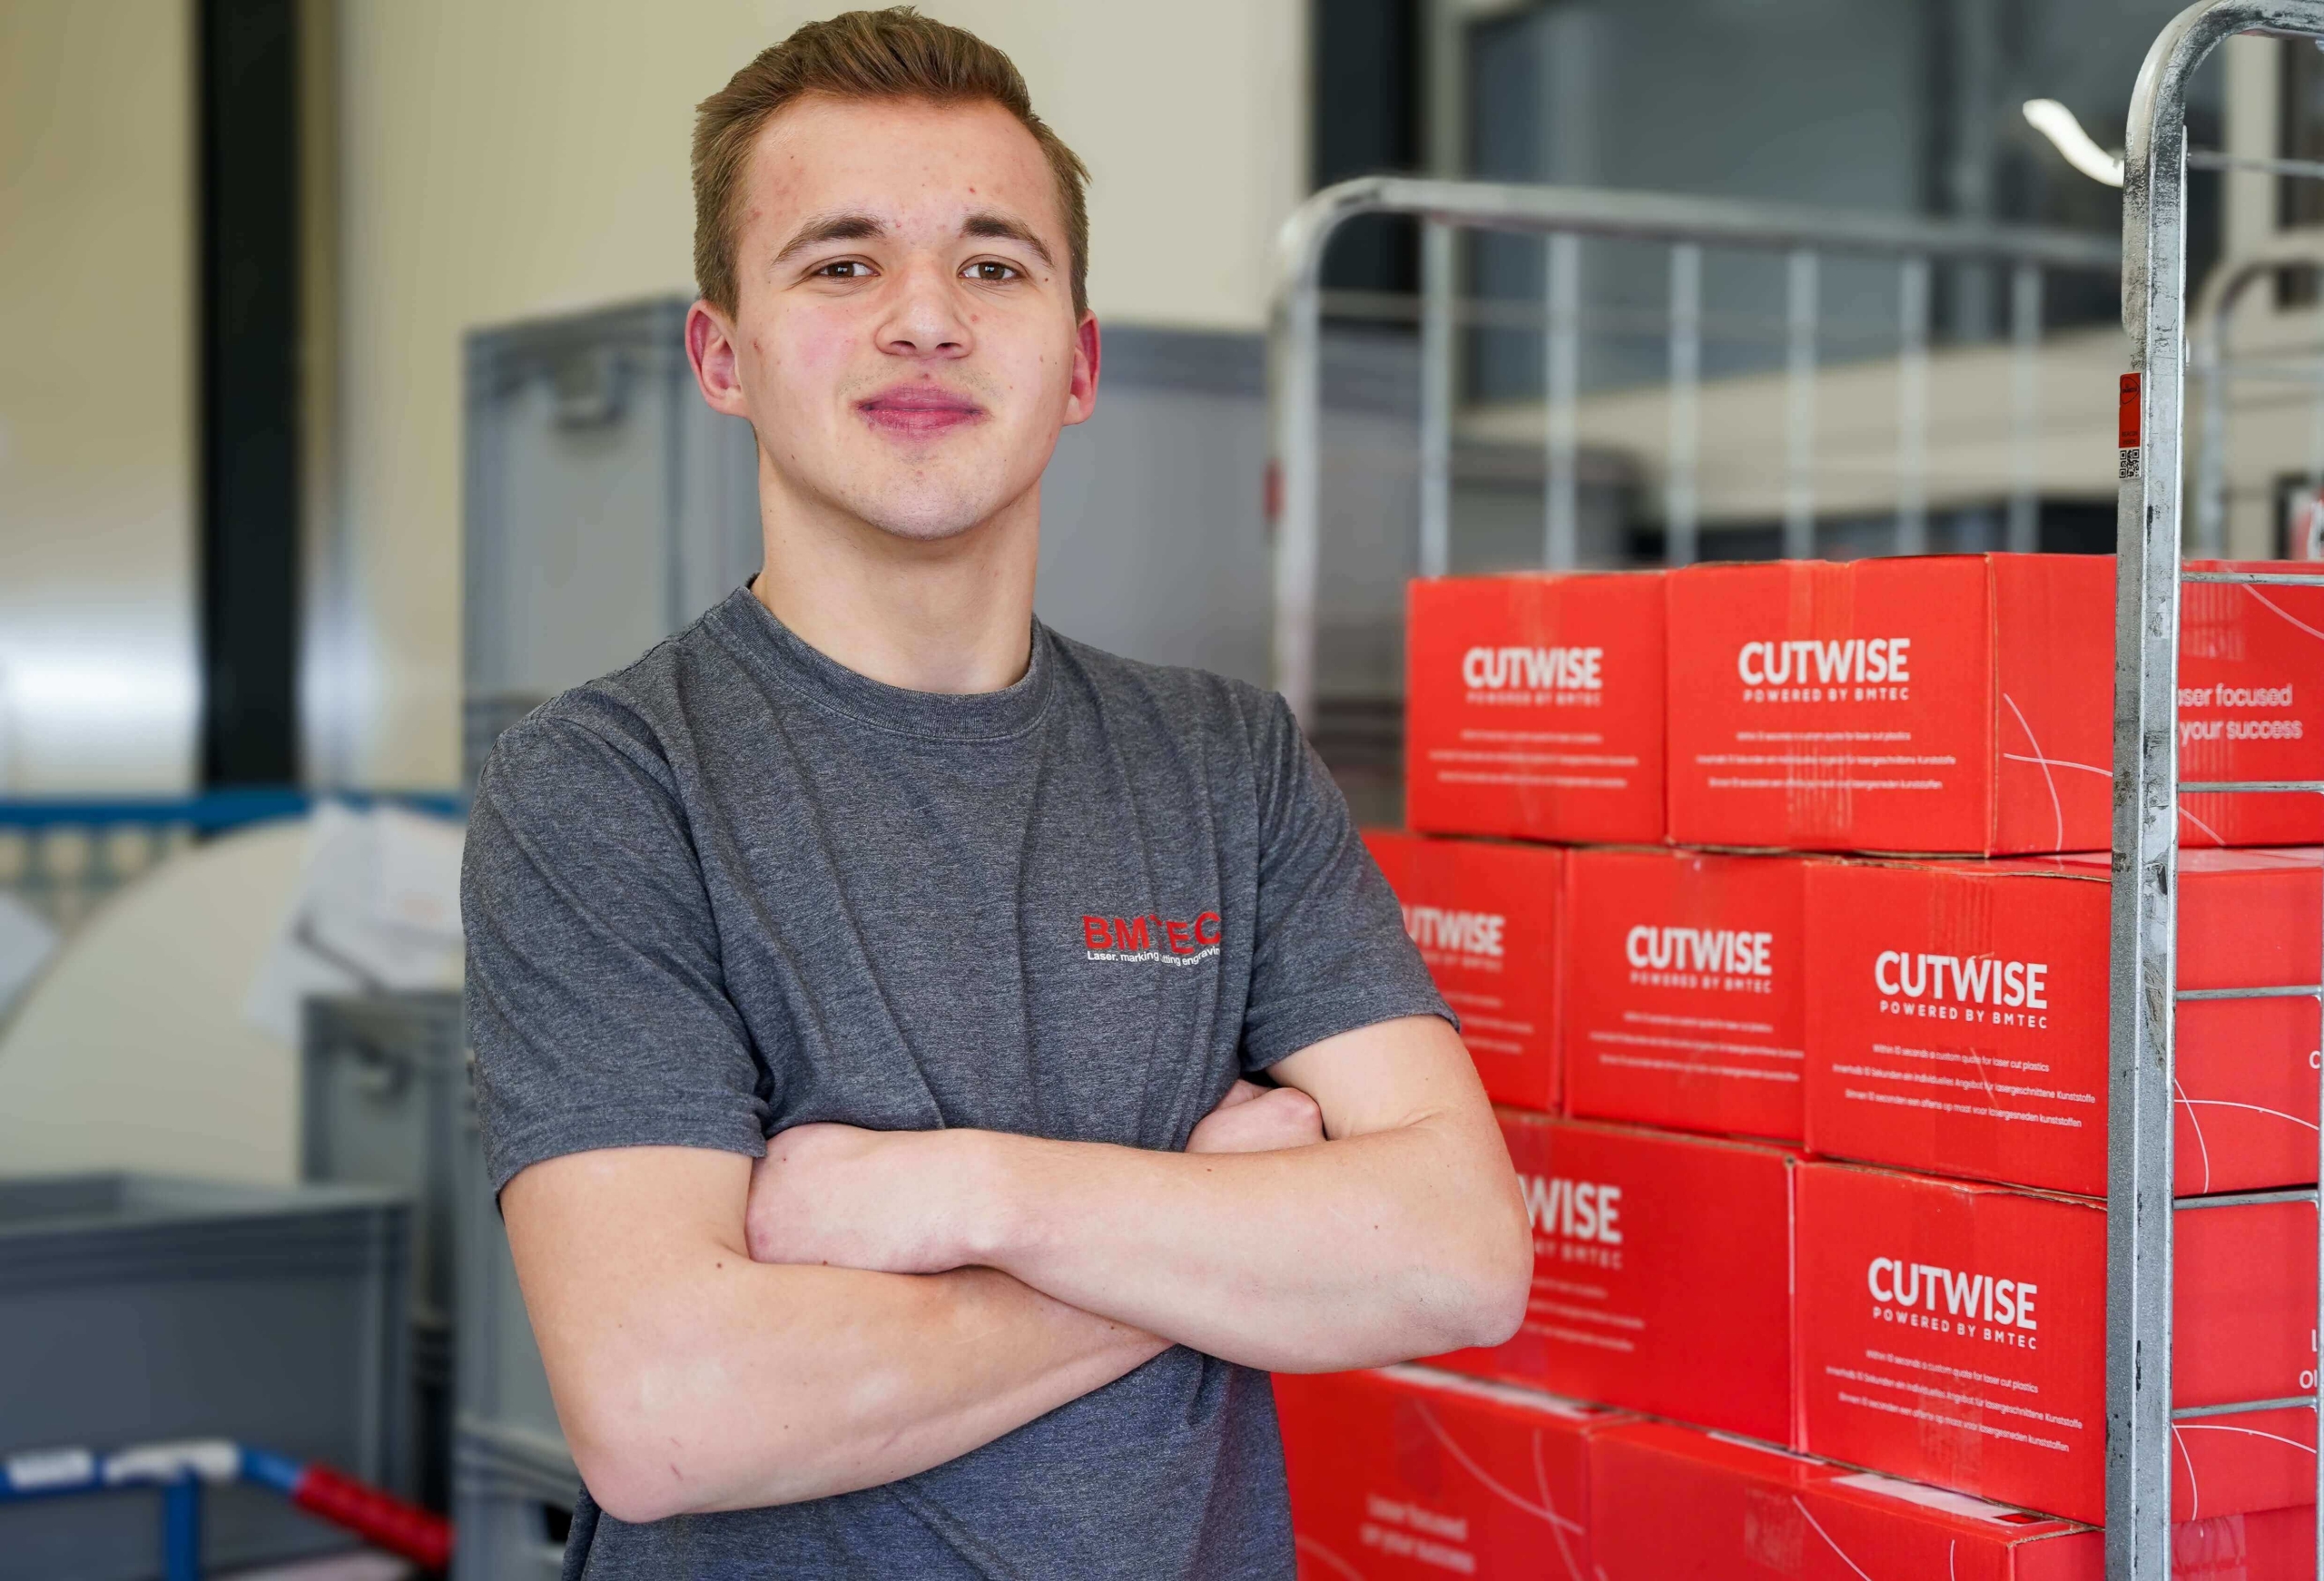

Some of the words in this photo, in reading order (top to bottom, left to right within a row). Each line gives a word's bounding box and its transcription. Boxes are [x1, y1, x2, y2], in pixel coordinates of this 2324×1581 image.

[1463, 647, 1603, 690] CUTWISE
[1738, 638, 1910, 684] CUTWISE
[1743, 689, 1821, 702] POWERED
[1828, 688, 1847, 702] BY
[1855, 687, 1908, 702] BMTEC
[2215, 682, 2292, 707] focused
[2180, 721, 2223, 746] your
[2226, 720, 2303, 740] success
[1401, 906, 1504, 956] UTWISE
[1120, 951, 1159, 962] marking
[1182, 946, 1220, 966] engravin
[1627, 926, 1772, 976] CUTWISE
[1875, 950, 2048, 1009] CUTWISE
[1880, 1000, 1958, 1019] POWERED
[1965, 1009, 1984, 1022] BY
[1993, 1012, 2047, 1028] BMTEC
[2023, 1061, 2050, 1072] plastics
[2057, 1091, 2095, 1103] Kunststoffe
[2040, 1115, 2082, 1127] kunststoffen
[1517, 1174, 1622, 1243] WISE
[1868, 1258, 2038, 1330] CUTWISE
[1874, 1307, 1949, 1332] POWERED
[1957, 1322, 1975, 1337] BY
[1983, 1329, 2037, 1349] BMTEC
[2013, 1381, 2038, 1393] plastics
